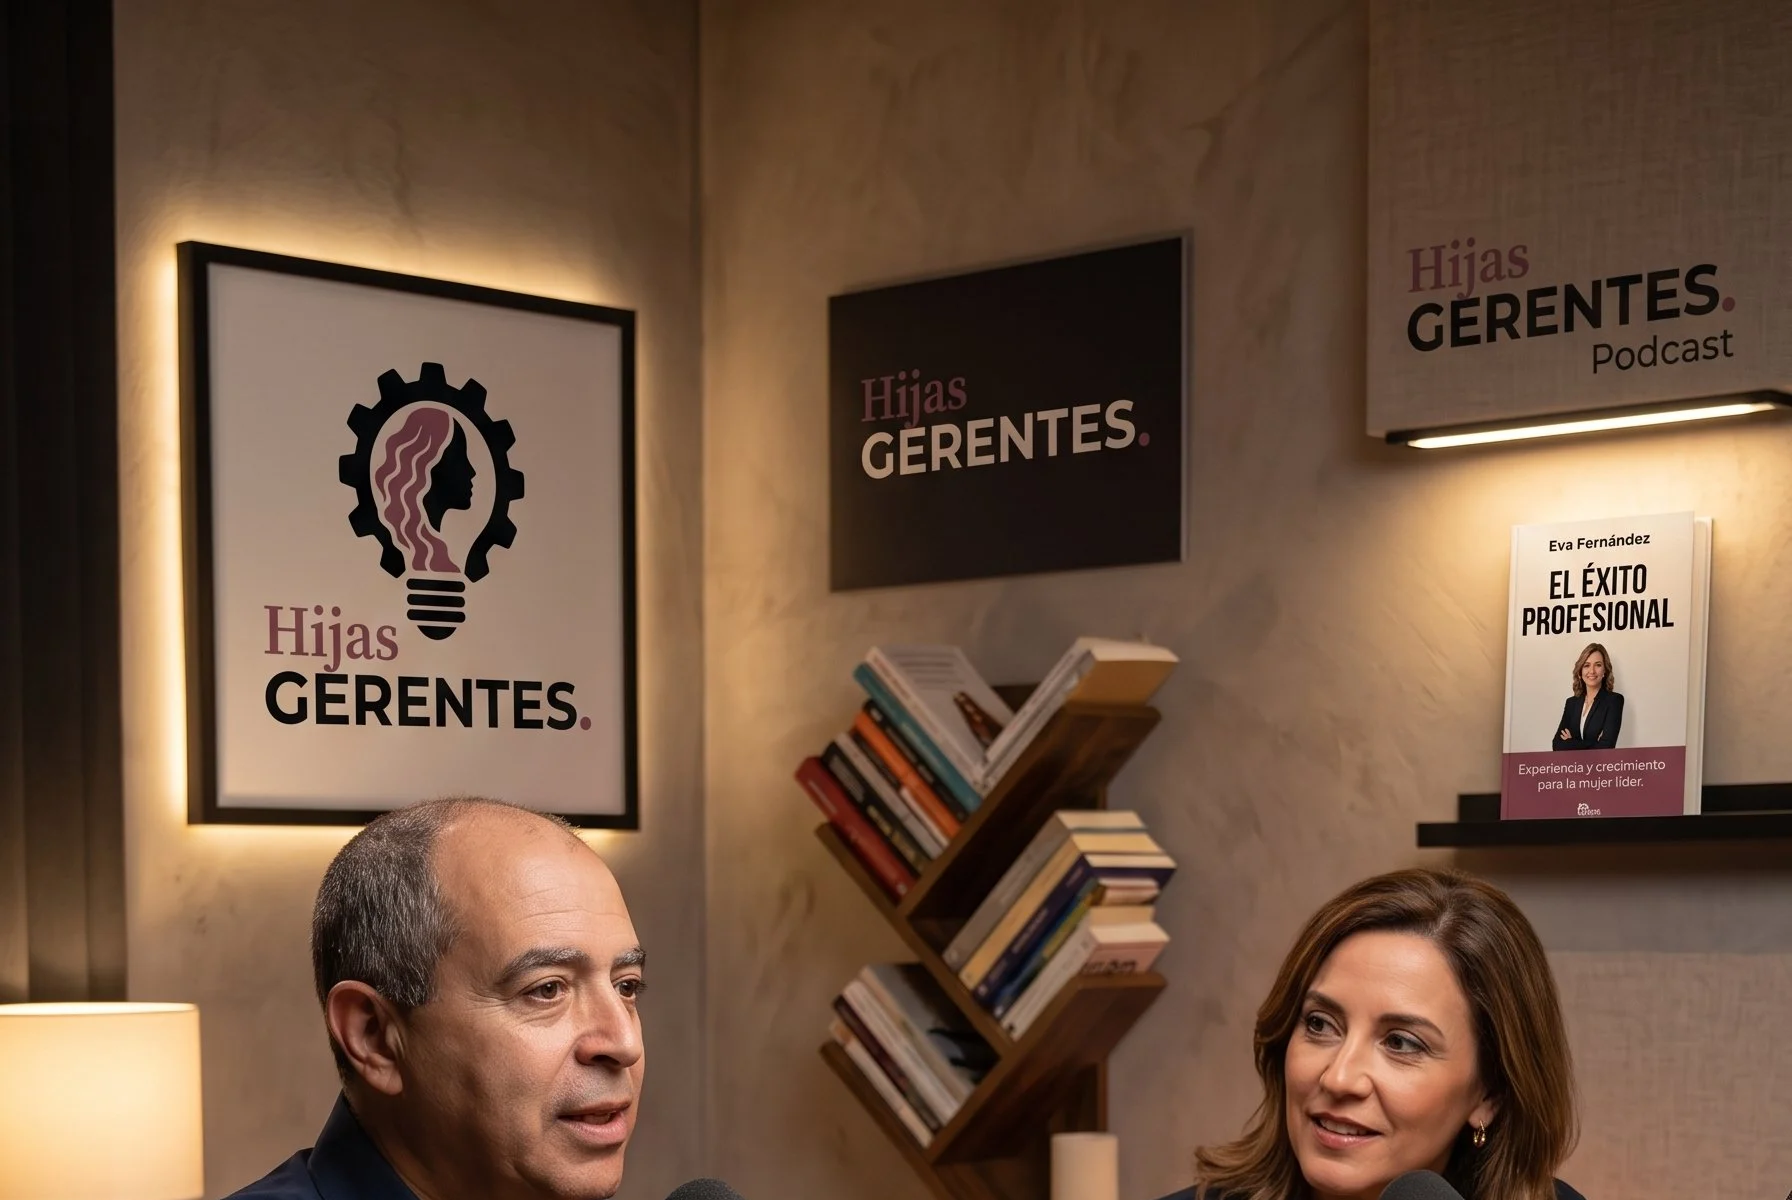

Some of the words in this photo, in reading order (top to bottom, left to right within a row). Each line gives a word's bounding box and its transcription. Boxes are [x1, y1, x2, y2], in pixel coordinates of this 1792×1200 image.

[1407, 237, 1530, 299] Hijas
[1407, 264, 1735, 352] GERENTES.
[1593, 330, 1734, 374] Podcast
[861, 369, 967, 428] Hijas
[861, 400, 1150, 479] GERENTES.
[1549, 540, 1573, 552] Eva
[1577, 533, 1651, 549] Fernández
[1549, 570, 1575, 599] EL
[1582, 562, 1647, 597] ÉXITO
[264, 605, 398, 672] Hijas
[1522, 598, 1674, 636] PROFESIONAL
[265, 671, 592, 731] GERENTES.
[1518, 762, 1584, 776] Experiencia
[1586, 764, 1593, 776] y
[1595, 759, 1666, 772] crecimiento
[1538, 780, 1563, 792] para
[1566, 778, 1576, 789] la
[1579, 776, 1613, 790] mujer
[1615, 776, 1644, 787] líder.
